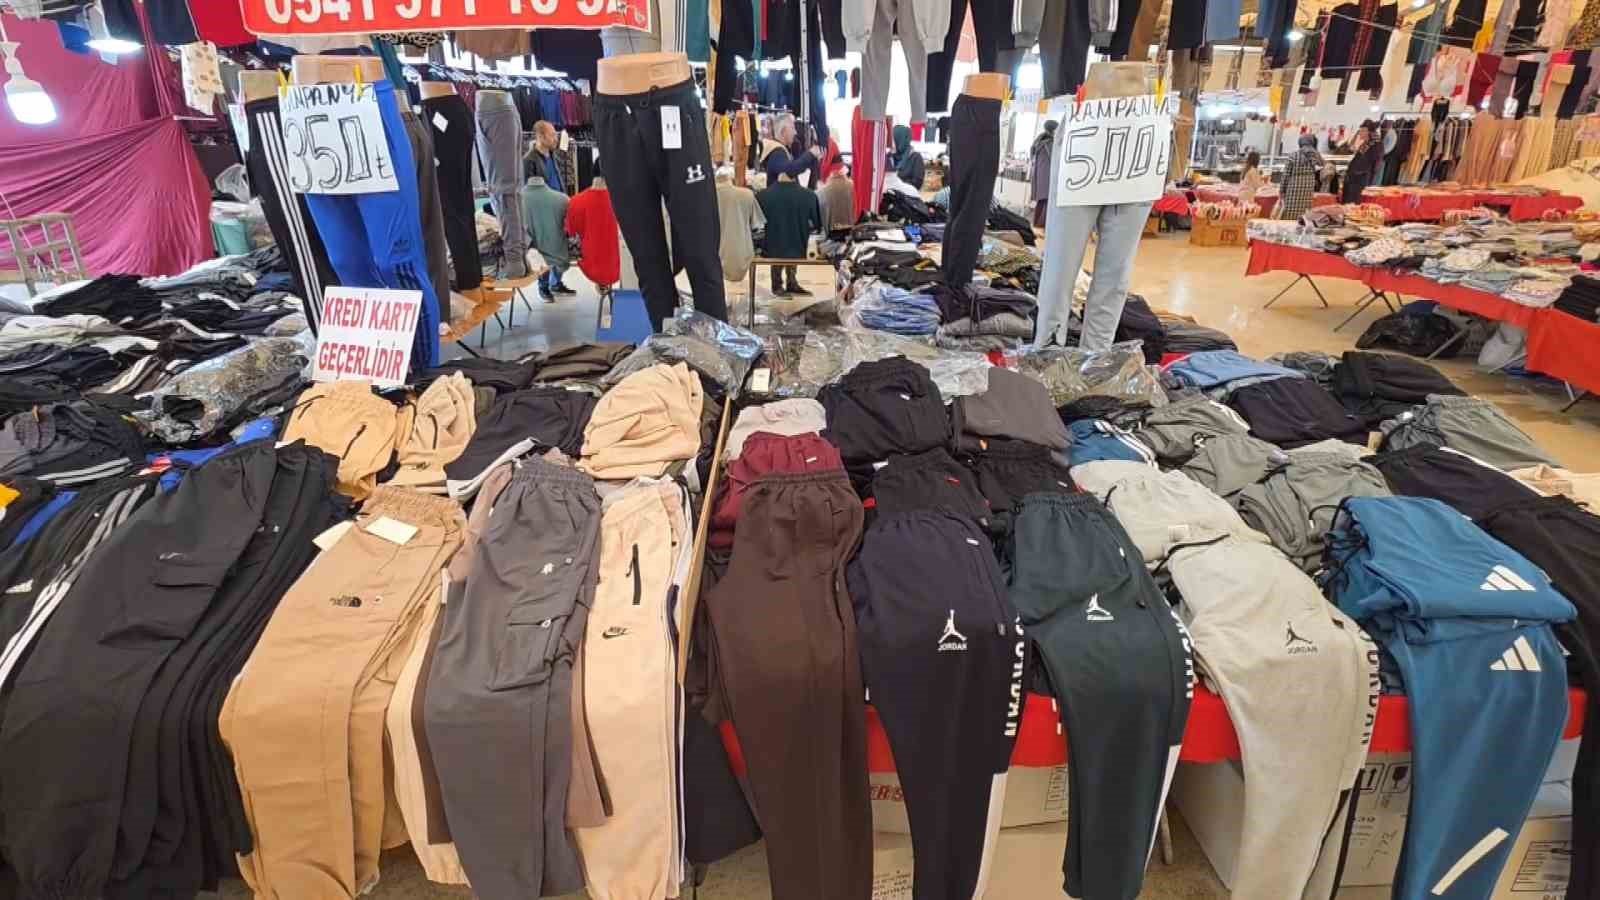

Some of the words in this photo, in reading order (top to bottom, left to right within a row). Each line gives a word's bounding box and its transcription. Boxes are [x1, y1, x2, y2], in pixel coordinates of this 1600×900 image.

[322, 292, 368, 329] KREDİ
[369, 299, 418, 333] KARTI
[319, 339, 404, 381] GEÇERLİDİR
